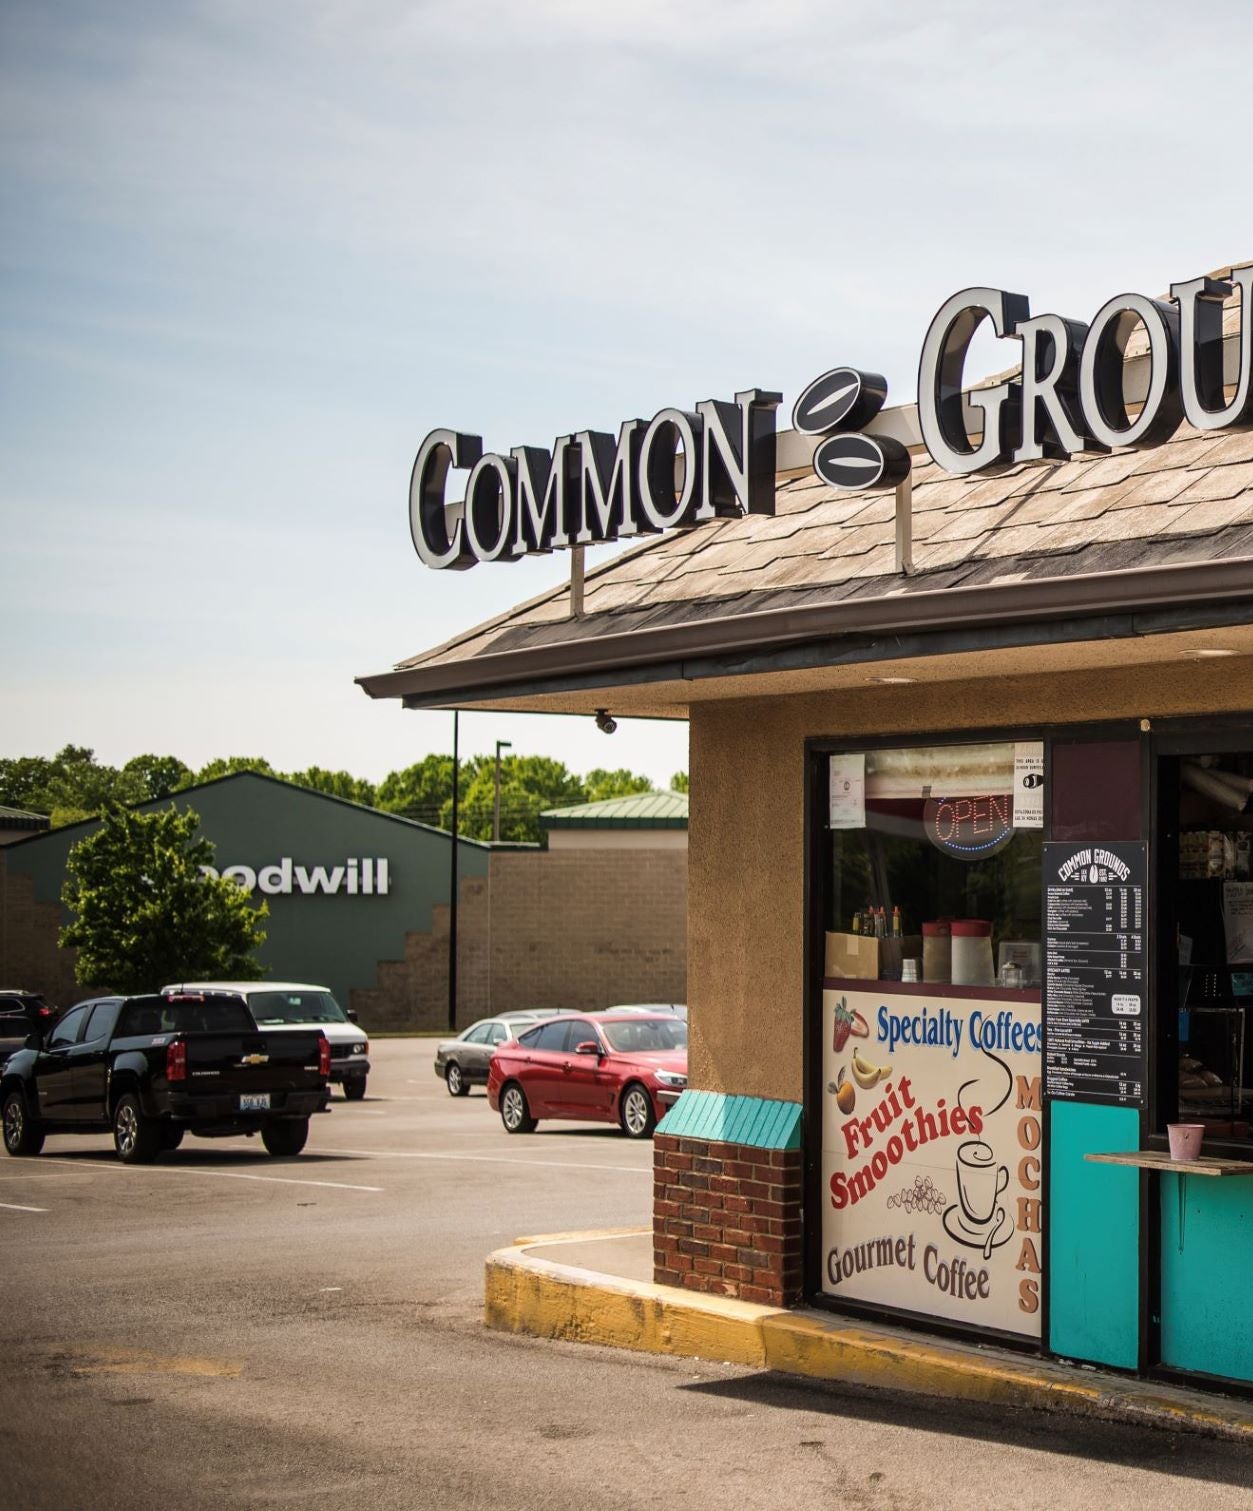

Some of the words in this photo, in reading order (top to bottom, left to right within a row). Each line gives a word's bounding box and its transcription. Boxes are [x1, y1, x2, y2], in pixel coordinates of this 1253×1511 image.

[409, 388, 783, 570] COMMON
[936, 794, 1008, 841] OPEN
[1058, 848, 1092, 882] COMMON
[1093, 848, 1131, 882] GROUNDS
[877, 1006, 963, 1057] Specialty
[830, 1099, 983, 1210] Smoothies
[841, 1075, 915, 1159] Fruit
[1016, 1075, 1042, 1314] MOCHAS
[827, 1232, 916, 1285] Gourmet
[923, 1244, 990, 1300] Coffee
